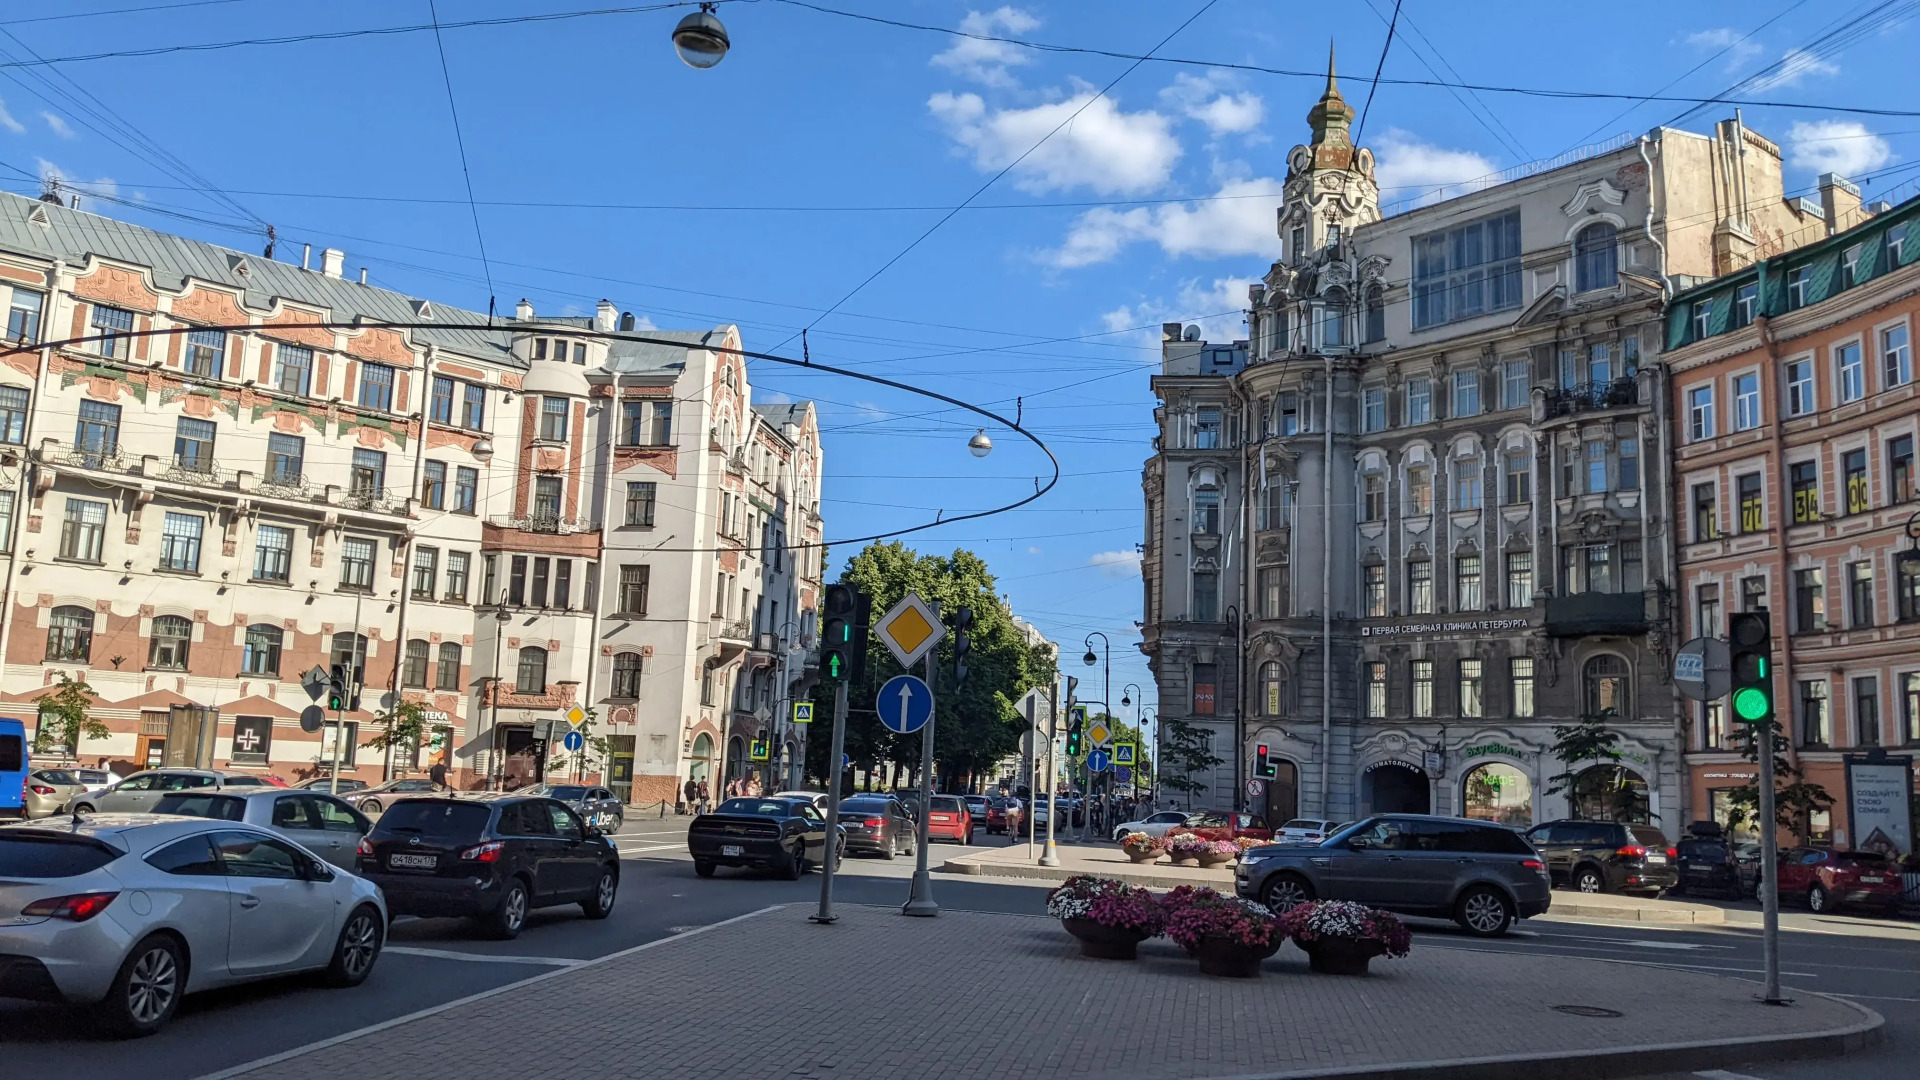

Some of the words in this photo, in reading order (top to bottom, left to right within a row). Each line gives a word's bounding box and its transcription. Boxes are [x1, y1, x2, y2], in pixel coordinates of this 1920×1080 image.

[1372, 625, 1399, 635] ПЕРВАЯ
[1401, 623, 1441, 634] СЕМЕЙНАЯ
[1443, 621, 1477, 631] КЛИНИКА
[1478, 619, 1528, 630] ПЕТЕРБУРГА
[1366, 760, 1420, 774] СТОМАТОЛОГИЯ
[1483, 775, 1515, 786] КАФЕ
[1857, 789, 1901, 797] СОЗДАЙТЕ
[596, 811, 614, 826] Uber
